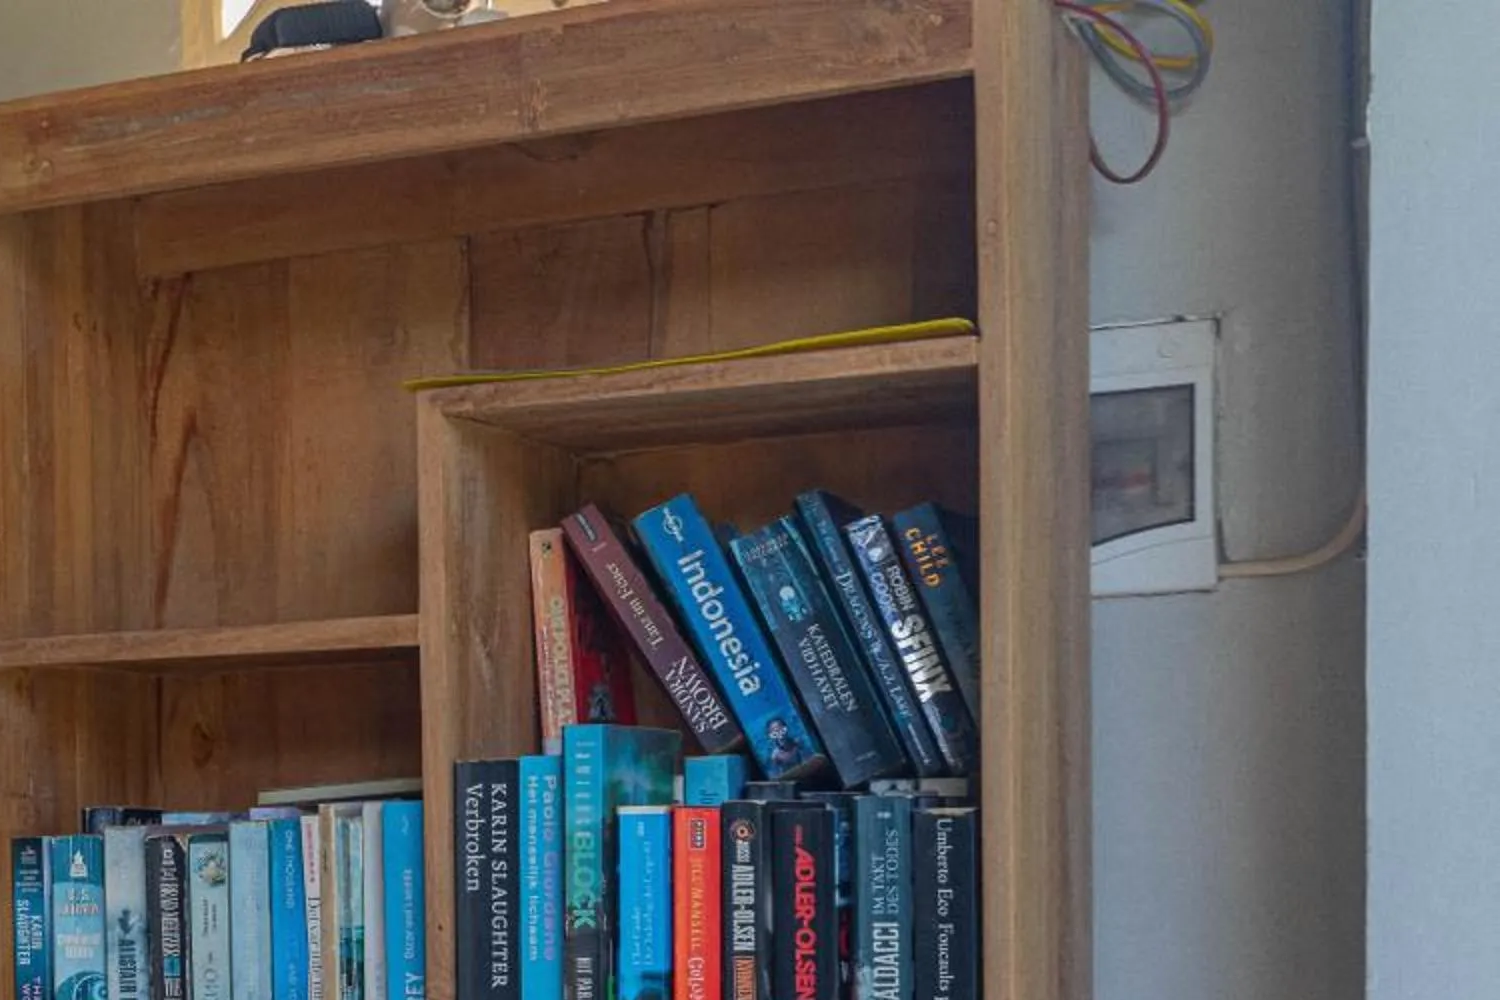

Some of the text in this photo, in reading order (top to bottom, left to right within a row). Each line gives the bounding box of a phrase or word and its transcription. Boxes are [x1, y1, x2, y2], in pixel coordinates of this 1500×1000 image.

[885, 564, 914, 611] ROBIN
[903, 525, 943, 589] CHILD
[628, 596, 645, 618] im
[676, 547, 763, 695] Indonesia
[869, 570, 898, 616] COOK
[807, 622, 859, 710] KATEDRALEN
[891, 613, 951, 703] SFINX
[664, 668, 709, 734] SANDRA
[673, 655, 728, 730] BROWN
[466, 783, 485, 893] Verbroken
[525, 775, 539, 961] Het menselijk lichaam
[543, 774, 558, 961] Paolo Giordano
[885, 829, 899, 914] DES TODES
[937, 818, 954, 884] Umberto
[491, 783, 508, 988] KARIN SLAUGHTER
[573, 836, 596, 929] BLOCK
[692, 858, 703, 887] JILL
[871, 854, 885, 914] IM TAKT
[937, 889, 954, 917] Eco
[16, 899, 31, 966] SLAUGHTER
[31, 915, 43, 950] KARIN
[691, 889, 703, 951] MANSELL
[732, 865, 756, 951] ADLER-OLSEN
[118, 939, 137, 993] ALISTAIR
[939, 923, 956, 992] Foucaults
